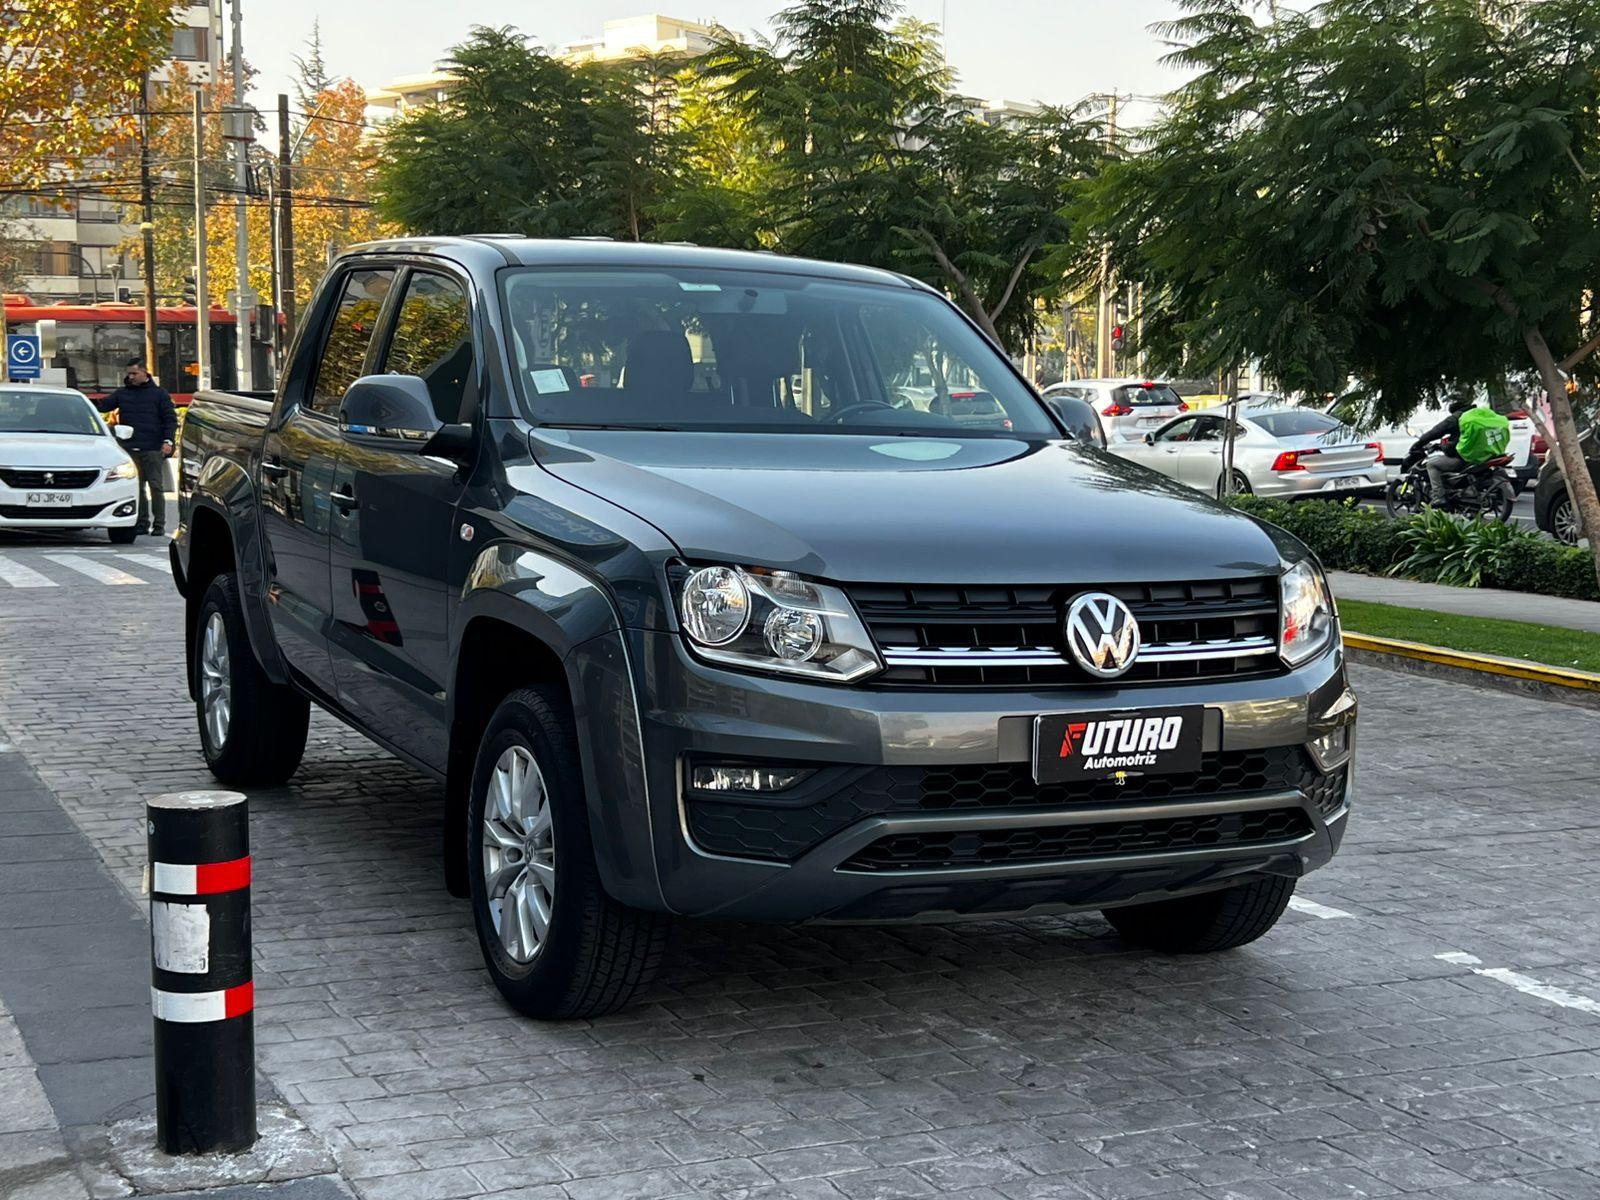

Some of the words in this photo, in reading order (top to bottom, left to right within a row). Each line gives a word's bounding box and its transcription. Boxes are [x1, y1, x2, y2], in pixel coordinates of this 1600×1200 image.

[1068, 595, 1138, 675] VW
[1060, 716, 1183, 757] FUTURO
[1083, 751, 1157, 770] Automotriz
